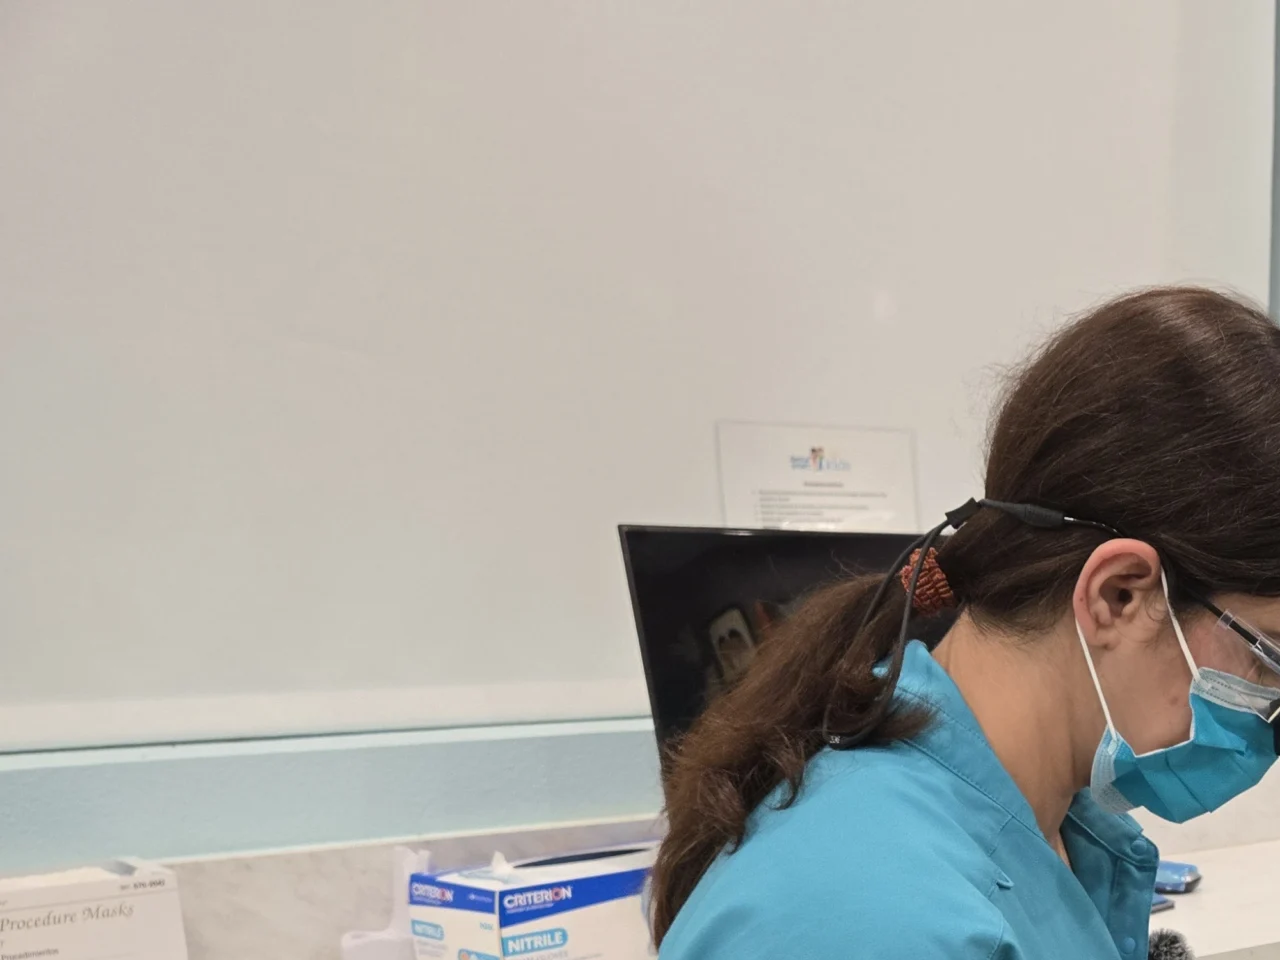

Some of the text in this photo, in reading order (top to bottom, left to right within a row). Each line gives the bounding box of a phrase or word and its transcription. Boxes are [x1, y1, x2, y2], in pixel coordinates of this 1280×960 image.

[503, 886, 572, 909] CRITERION
[0, 901, 135, 932] Procedure Masks
[507, 932, 563, 953] NITRILE
